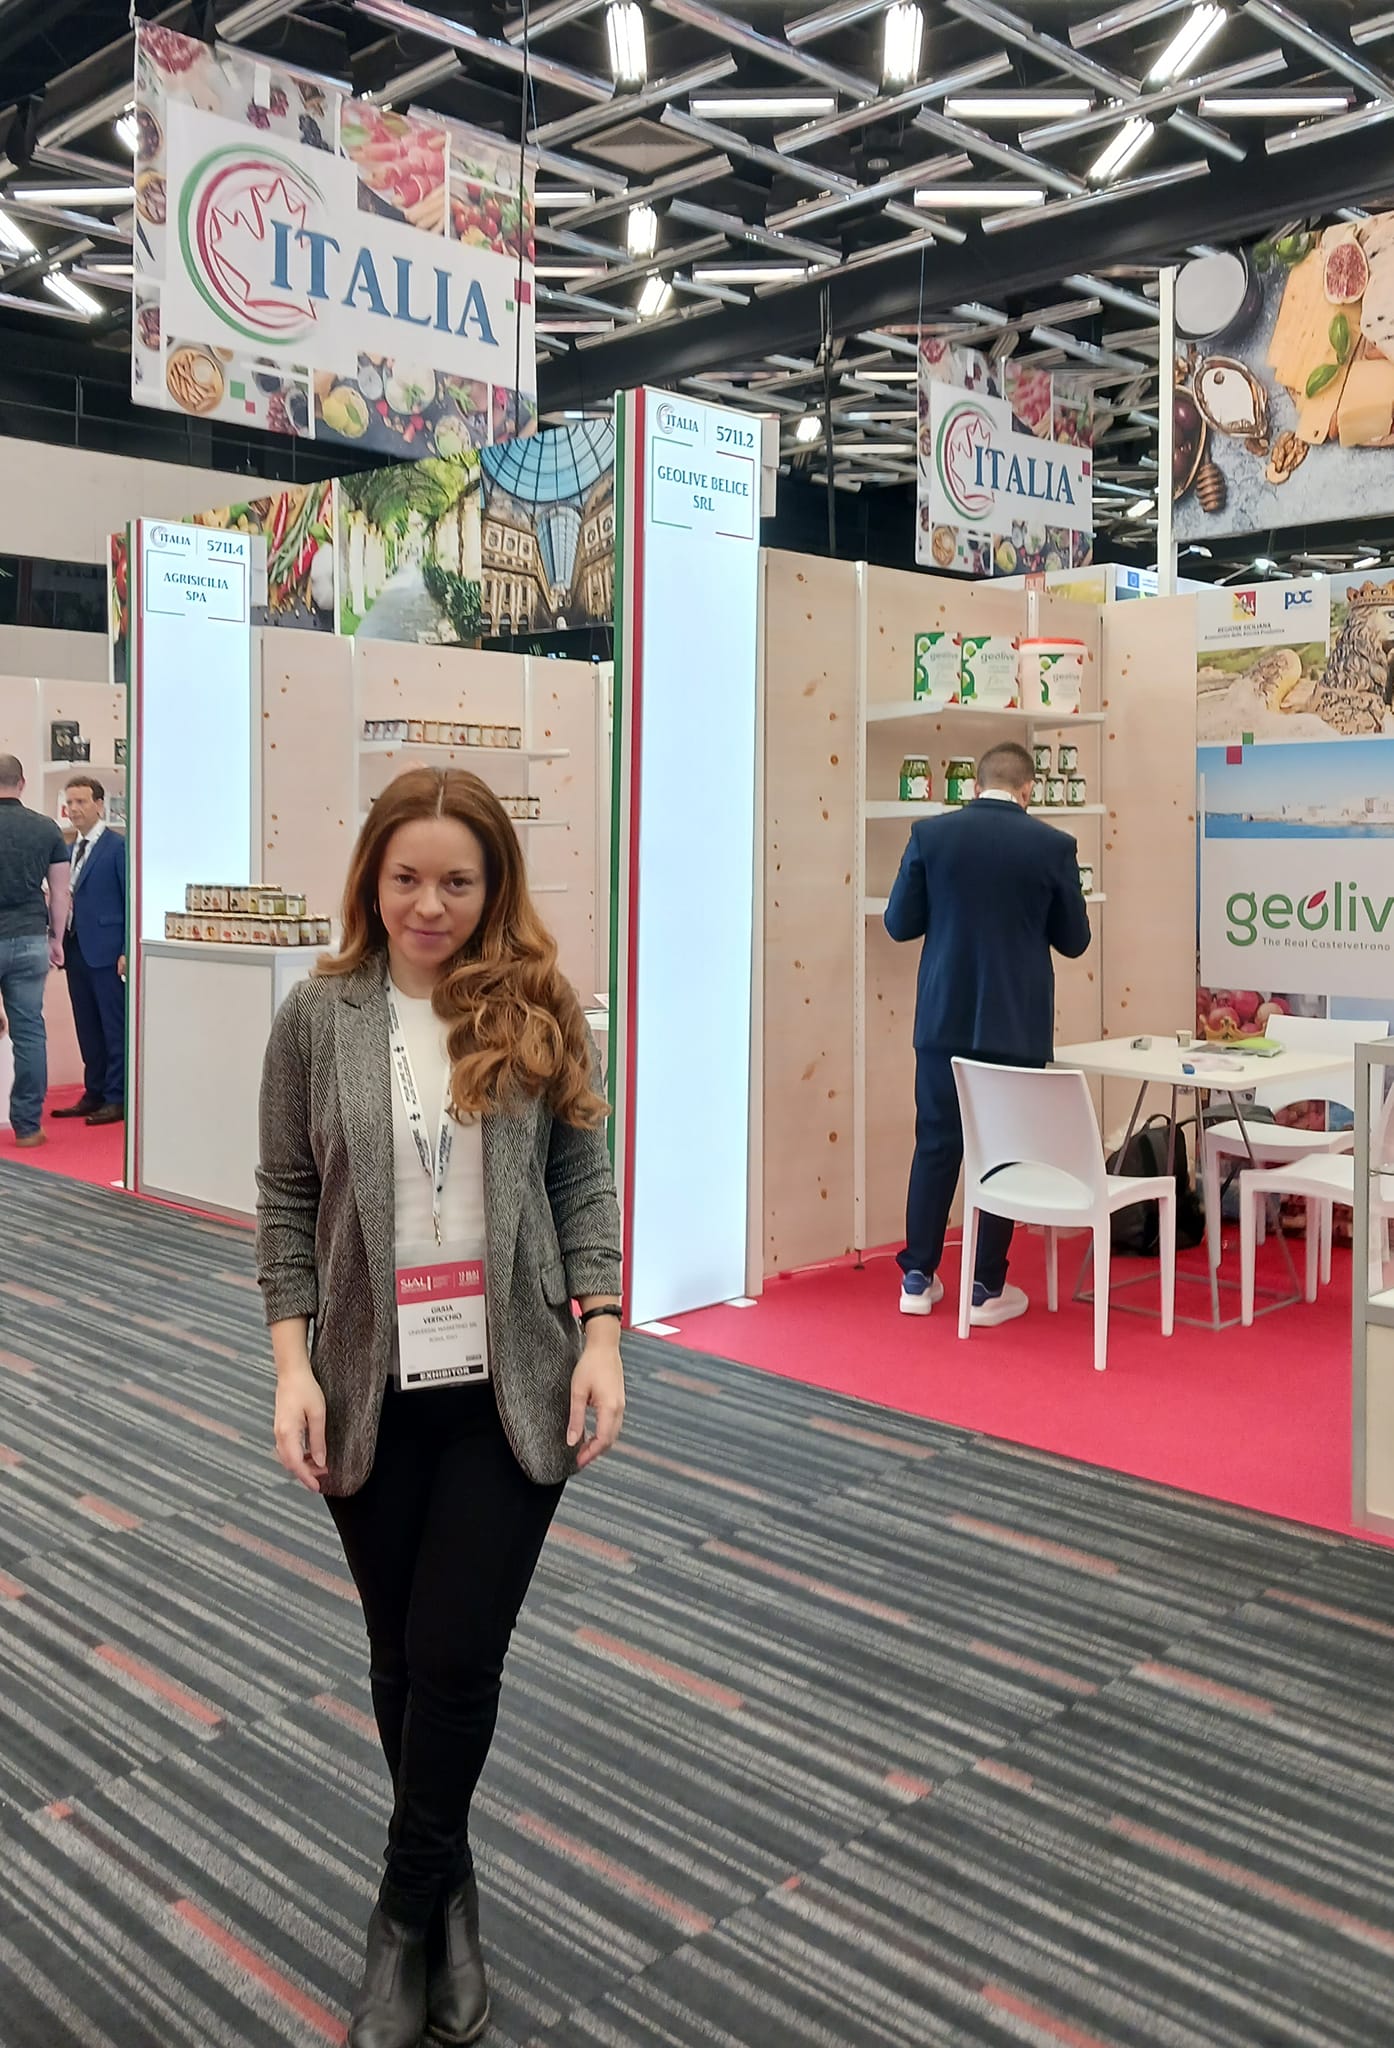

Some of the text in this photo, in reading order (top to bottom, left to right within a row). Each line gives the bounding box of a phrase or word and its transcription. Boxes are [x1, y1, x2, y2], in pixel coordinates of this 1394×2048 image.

[270, 219, 500, 347] ITALIA
[666, 414, 699, 433] ITALIA
[716, 425, 755, 448] 5711.2
[657, 465, 749, 497] GEOLIVE BELICE
[974, 444, 1075, 505] ITALIA
[693, 494, 716, 512] SRL
[160, 533, 191, 546] ITALIA
[207, 539, 244, 556] 5711.4
[163, 572, 229, 590] AGRISICILIA
[185, 590, 207, 603] SPA
[980, 650, 1016, 664] geolive
[1263, 937, 1391, 951] The Real Castelvetrano
[420, 1366, 470, 1381] EXHIBITOR
